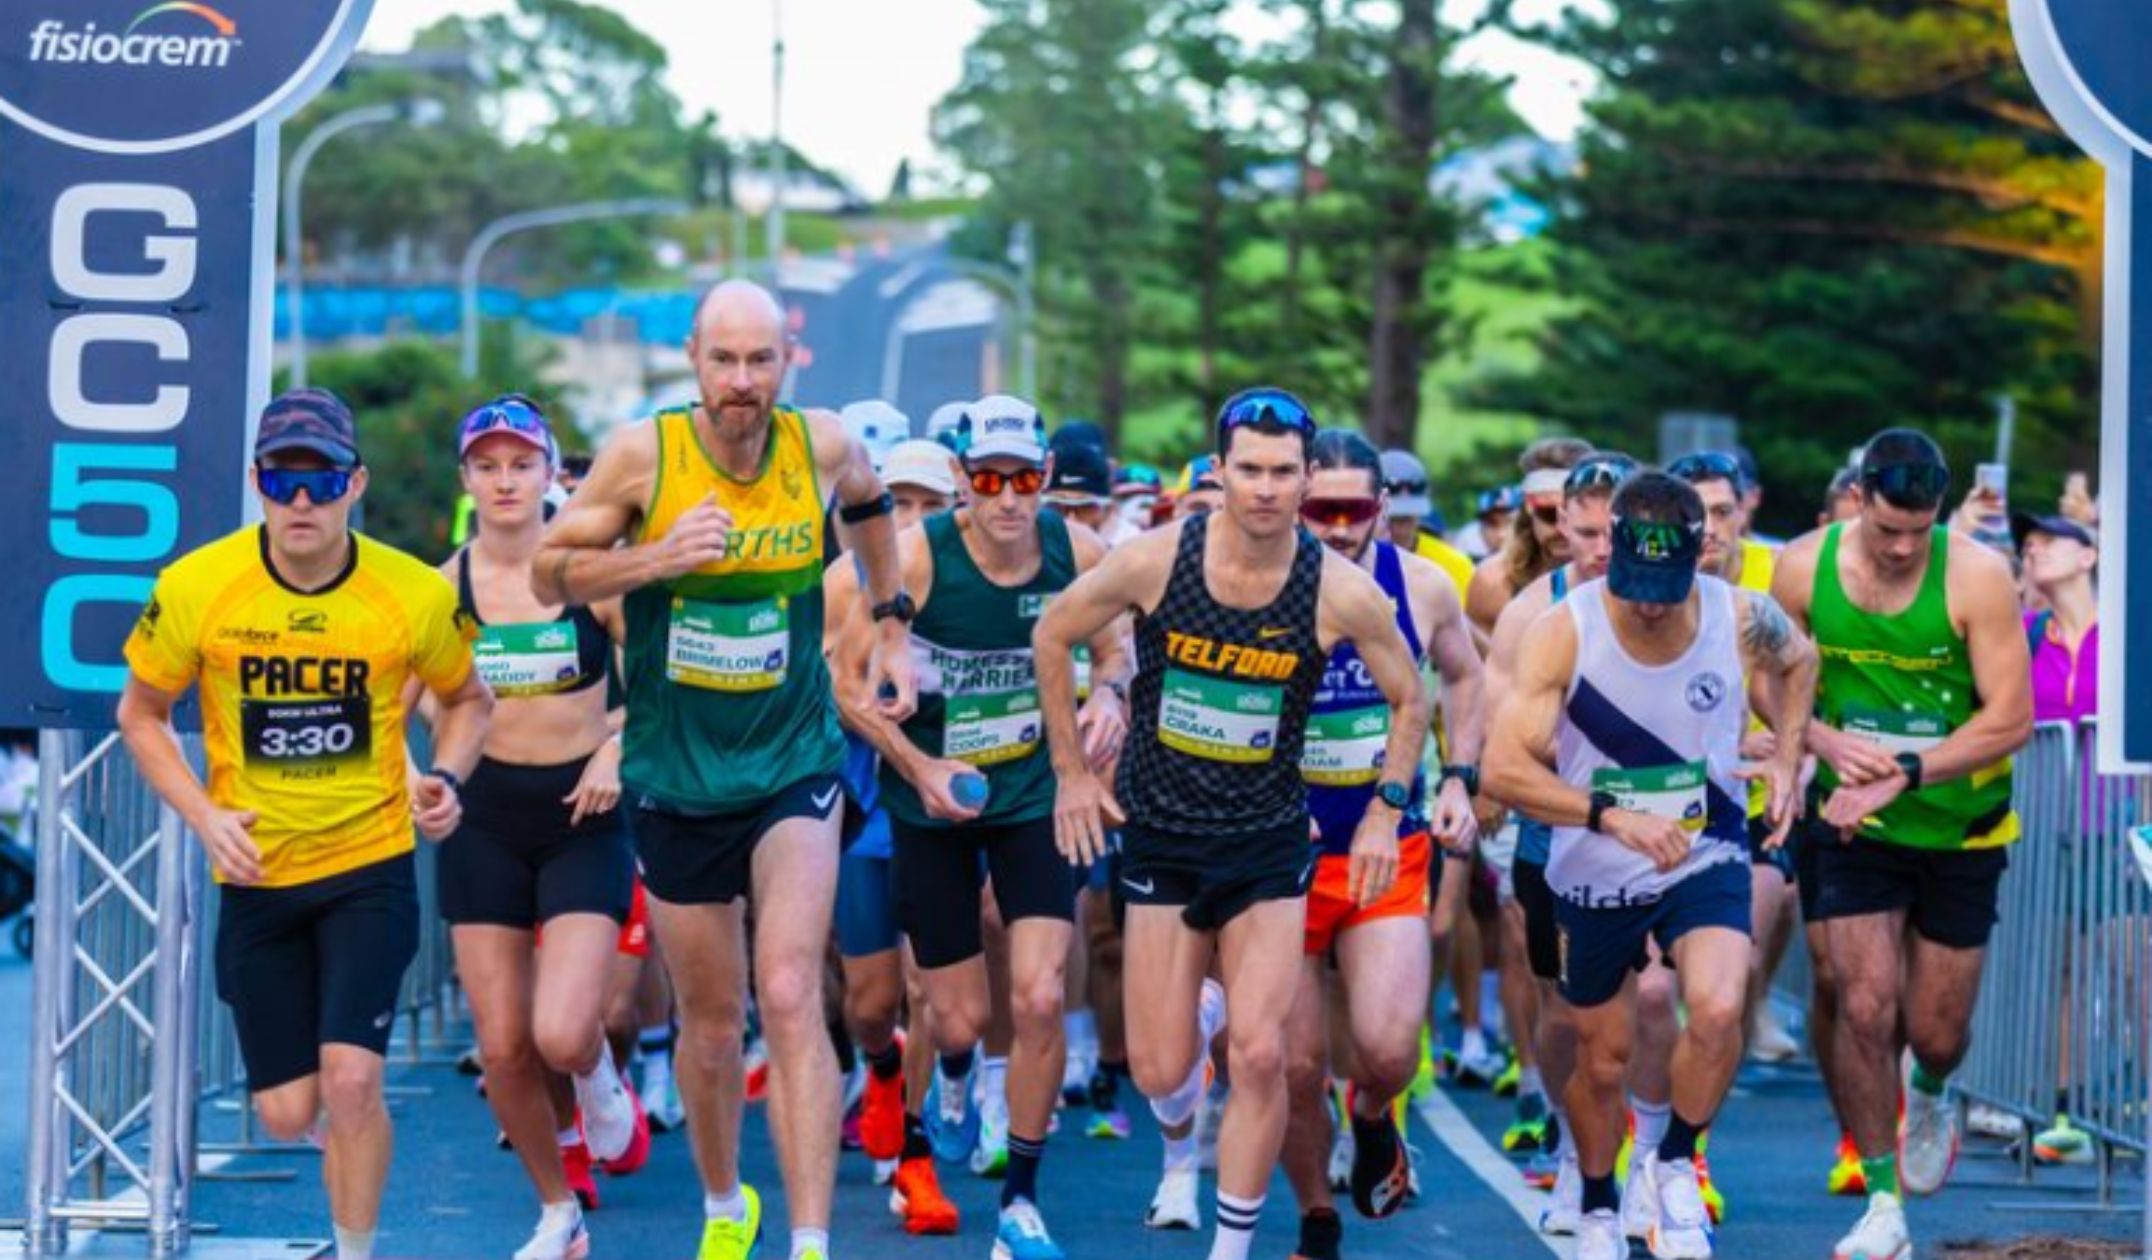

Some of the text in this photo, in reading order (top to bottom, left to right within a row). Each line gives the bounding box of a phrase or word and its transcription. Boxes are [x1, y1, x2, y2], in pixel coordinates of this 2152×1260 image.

[30, 20, 231, 67] fisiocrem
[724, 519, 813, 559] RTHS
[240, 655, 369, 697] PACER
[1166, 631, 1299, 680] TELFORD
[260, 722, 354, 757] 3:30
